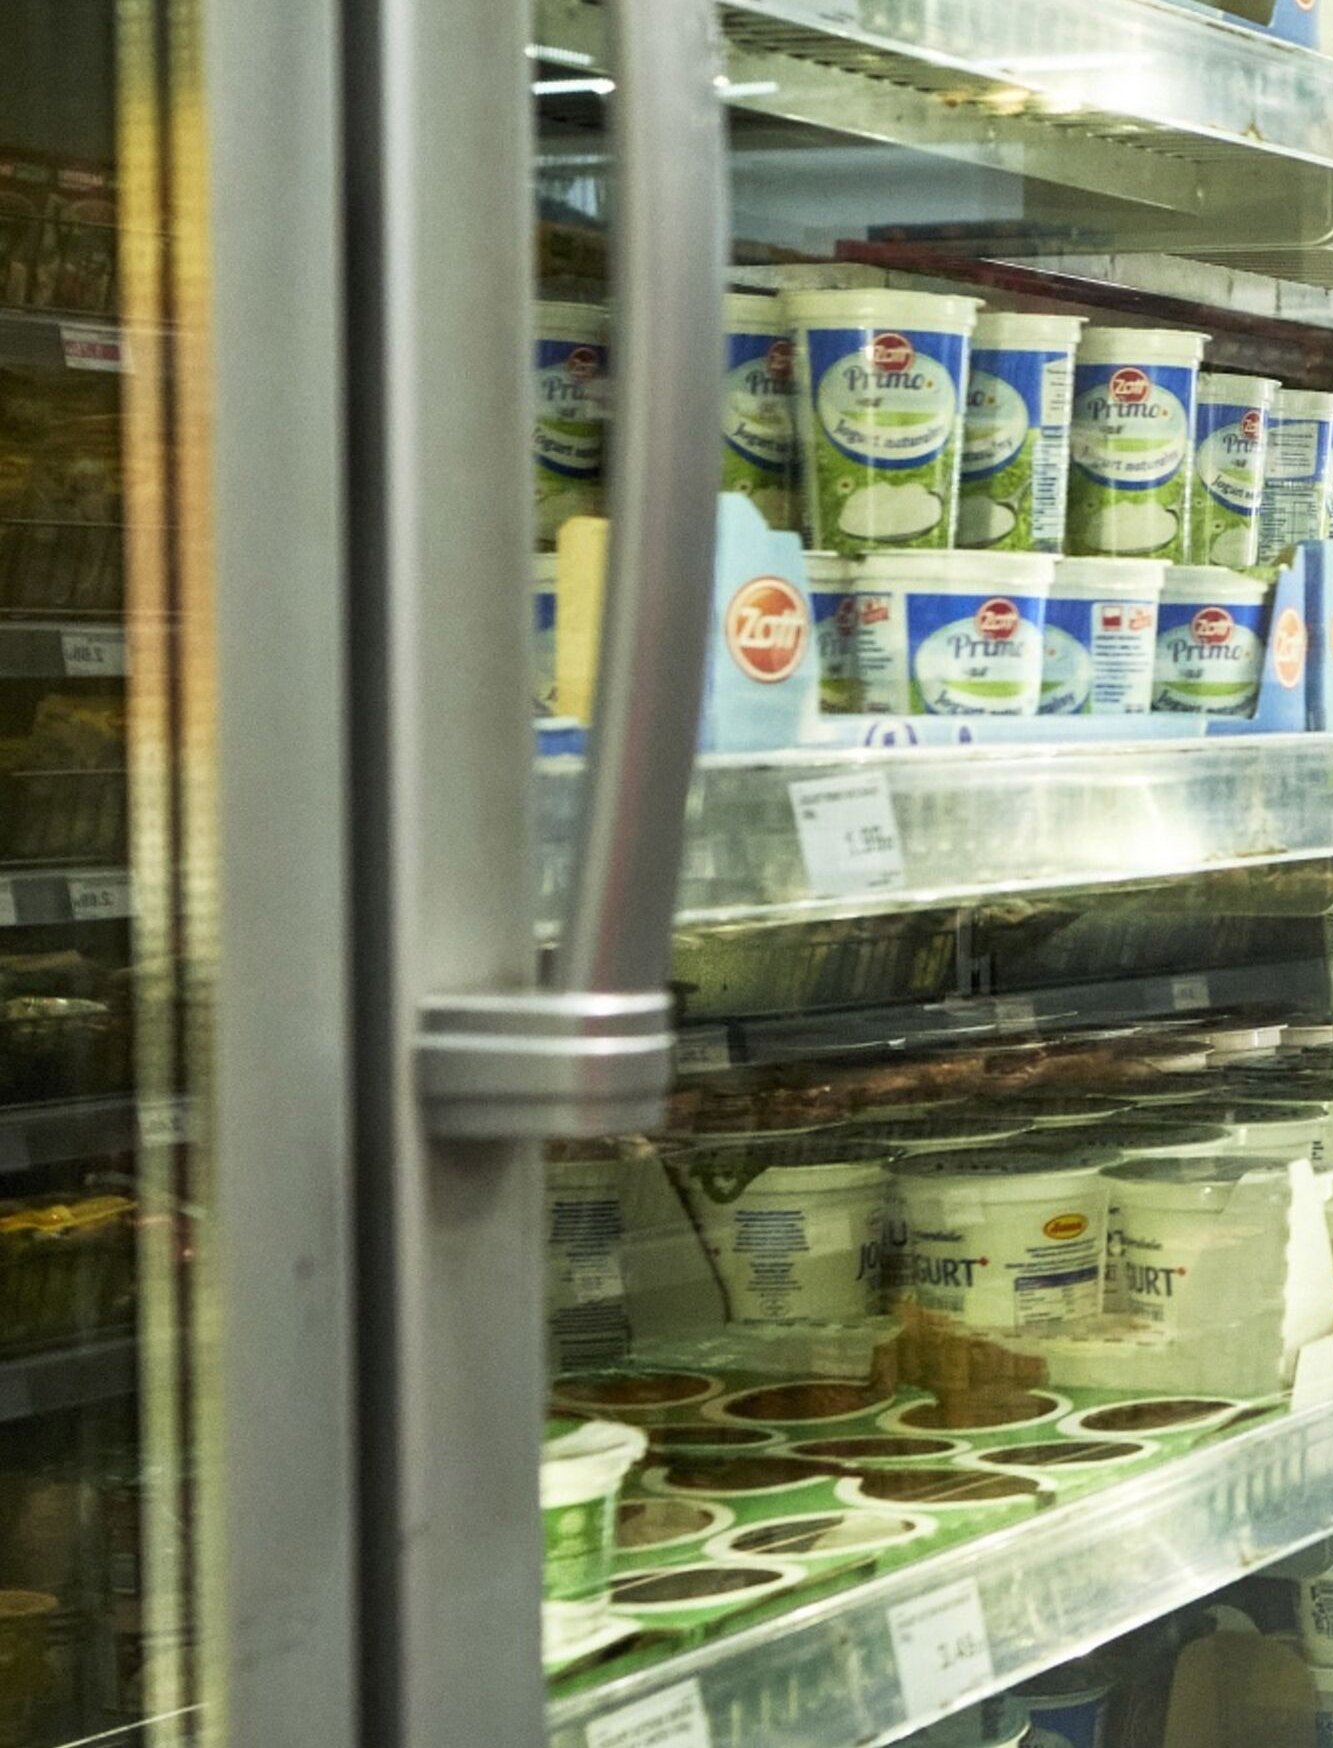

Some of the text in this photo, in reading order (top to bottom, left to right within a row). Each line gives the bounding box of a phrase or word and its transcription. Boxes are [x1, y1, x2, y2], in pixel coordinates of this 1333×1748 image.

[842, 365, 926, 392] Primo
[1087, 397, 1163, 420] Primo
[735, 607, 804, 649] Zott
[1167, 638, 1243, 662] Primo
